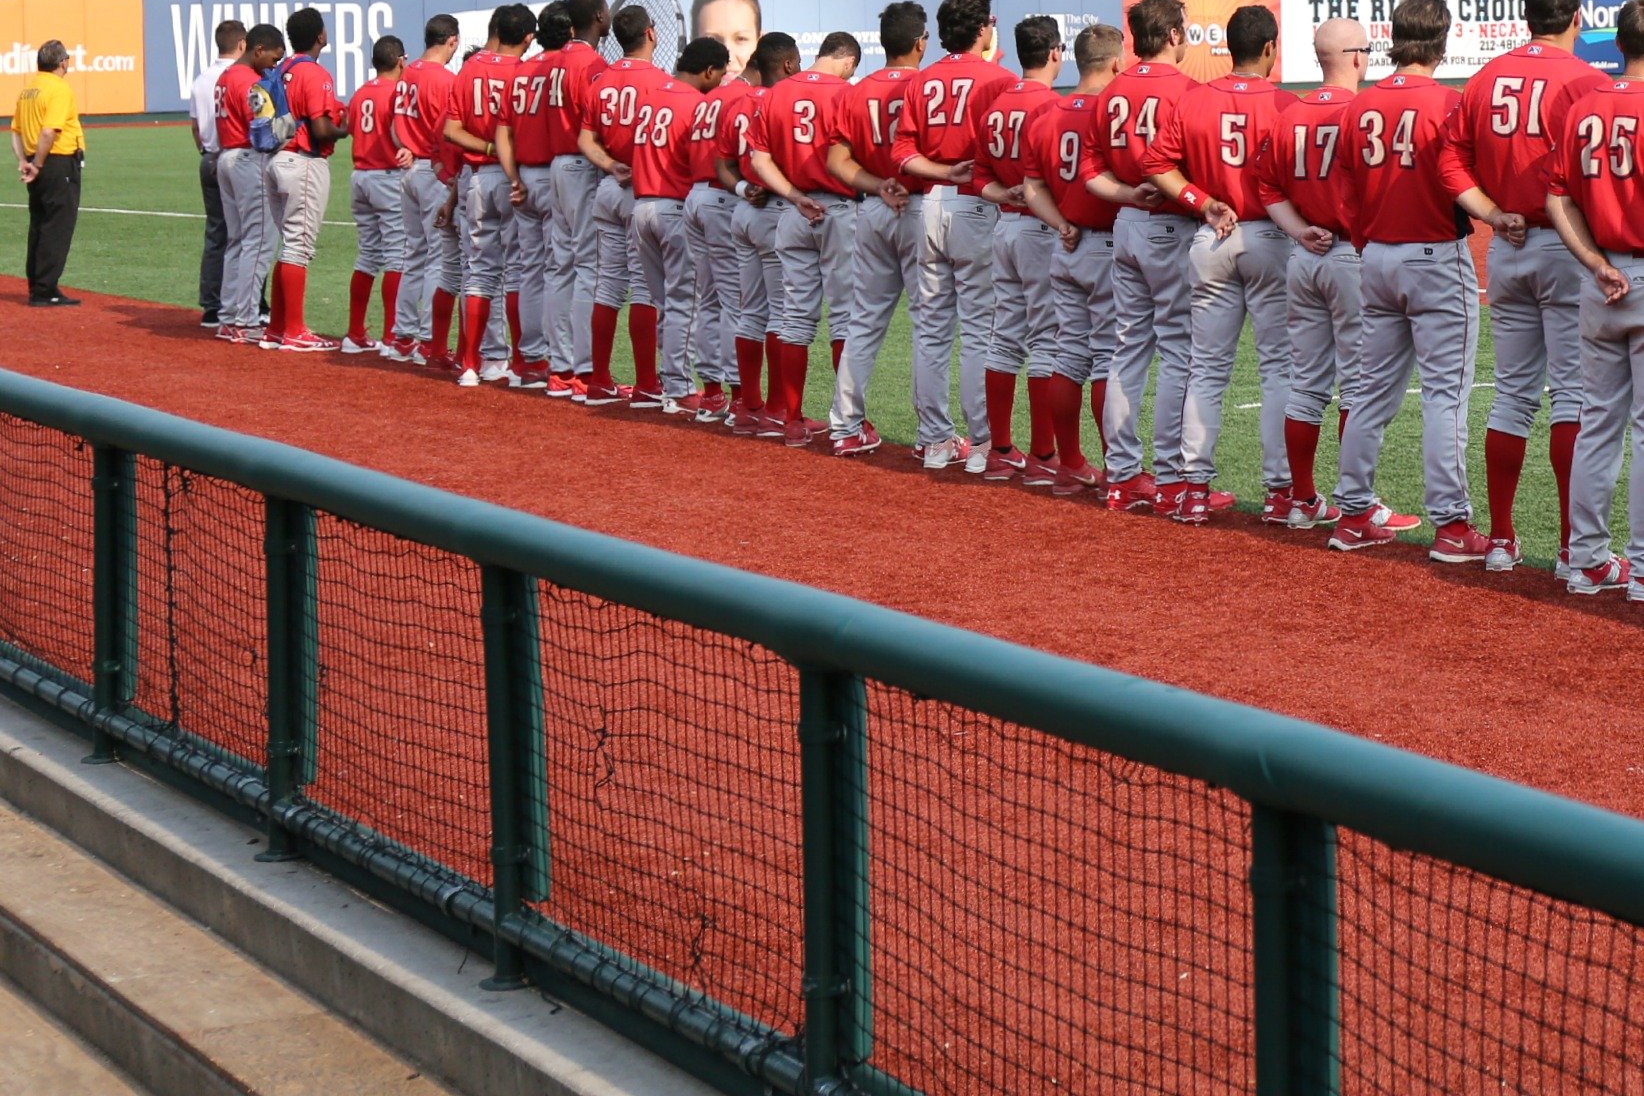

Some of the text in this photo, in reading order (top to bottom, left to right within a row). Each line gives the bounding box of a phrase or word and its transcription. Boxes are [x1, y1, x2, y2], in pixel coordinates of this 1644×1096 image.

[1066, 13, 1082, 24] The
[1456, 23, 1464, 38] 3
[360, 98, 375, 134] 8
[394, 79, 420, 119] 22
[472, 76, 505, 116] 15
[512, 75, 546, 116] 57
[599, 85, 637, 127] 30
[923, 76, 975, 127] 27
[1490, 75, 1548, 138] 51
[634, 104, 674, 148] 28
[691, 98, 722, 142] 29
[792, 98, 817, 145] 3
[986, 110, 1027, 161] 37
[1106, 94, 1161, 150] 24
[1219, 112, 1248, 168] 5
[1358, 108, 1419, 169] 34
[1058, 129, 1081, 183] 9
[1292, 123, 1340, 180] 17
[1576, 113, 1638, 180] 25
